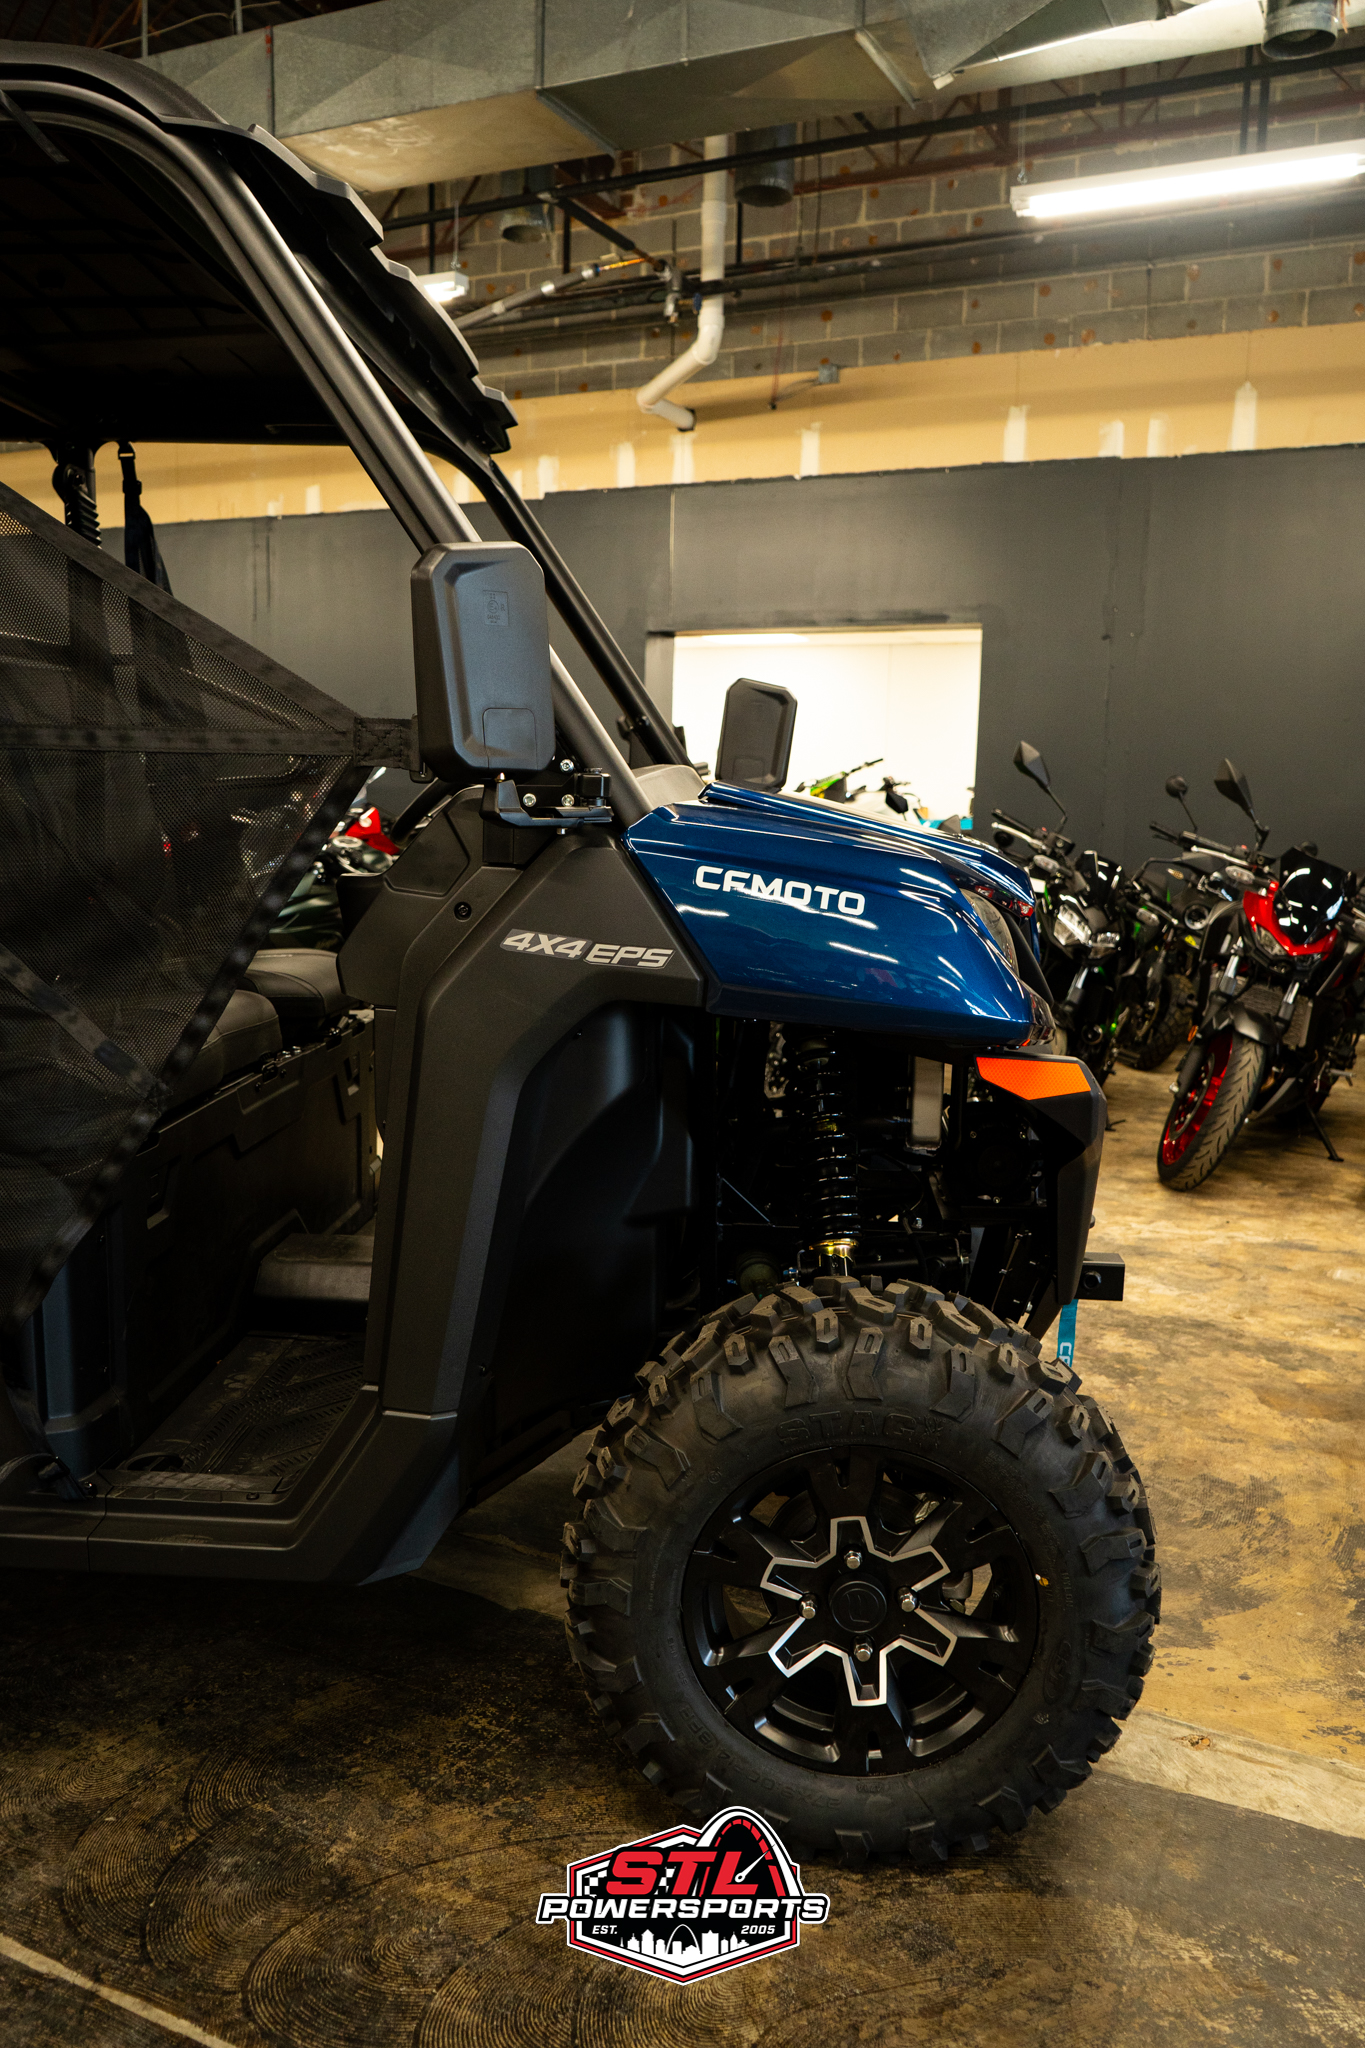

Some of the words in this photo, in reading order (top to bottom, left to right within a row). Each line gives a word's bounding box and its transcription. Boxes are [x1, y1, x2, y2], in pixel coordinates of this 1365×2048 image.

[694, 865, 866, 916] CFMOTO
[503, 932, 587, 959] 4X4
[585, 944, 676, 968] EPS
[776, 1411, 917, 1445] STAG
